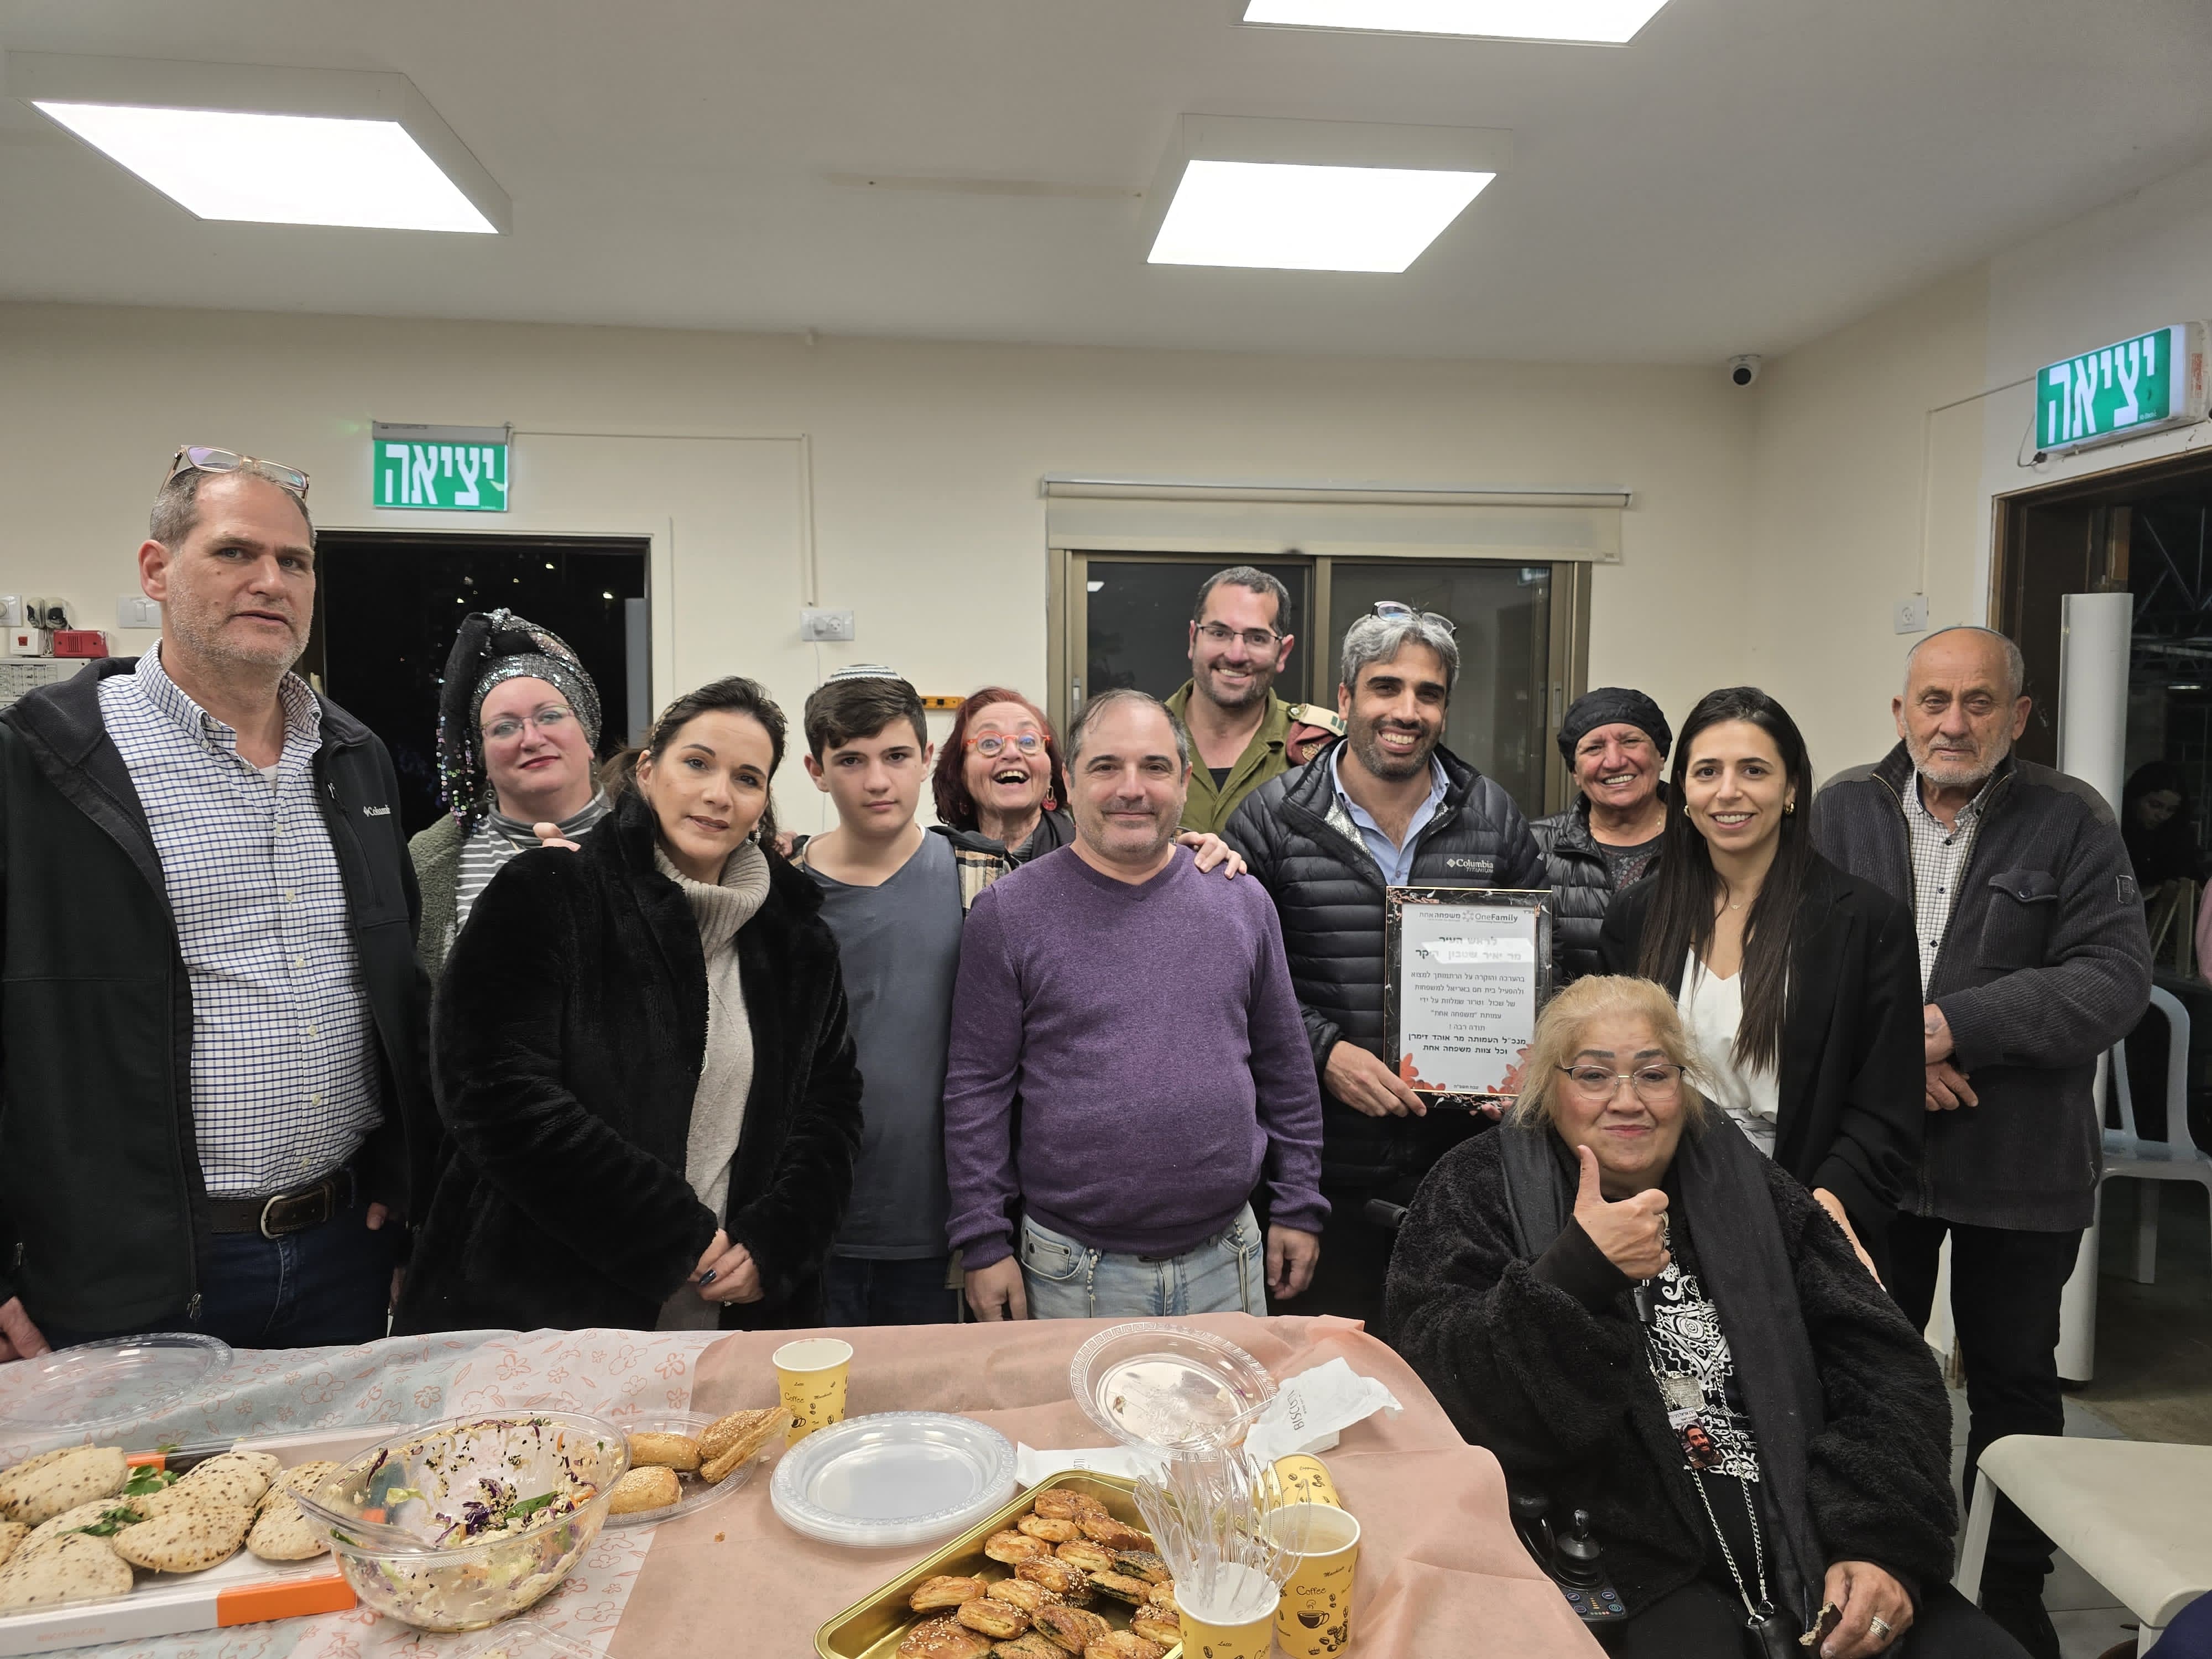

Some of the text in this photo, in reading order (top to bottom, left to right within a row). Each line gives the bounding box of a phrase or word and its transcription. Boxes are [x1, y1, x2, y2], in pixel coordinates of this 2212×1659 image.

[2048, 335, 2154, 445] יציאה
[385, 444, 494, 506] יציאה
[1456, 858, 1493, 868] Columbia
[1475, 913, 1518, 923] OneFamily
[1474, 974, 1497, 983] והוקרה
[1446, 984, 1470, 993] באריאל
[1498, 987, 1524, 995] ולהפעיל
[1468, 1035, 1499, 1044] העמותה
[1495, 1046, 1507, 1055] וכל
[784, 1392, 805, 1403] Coffee
[1296, 1585, 1327, 1595] Coffee
